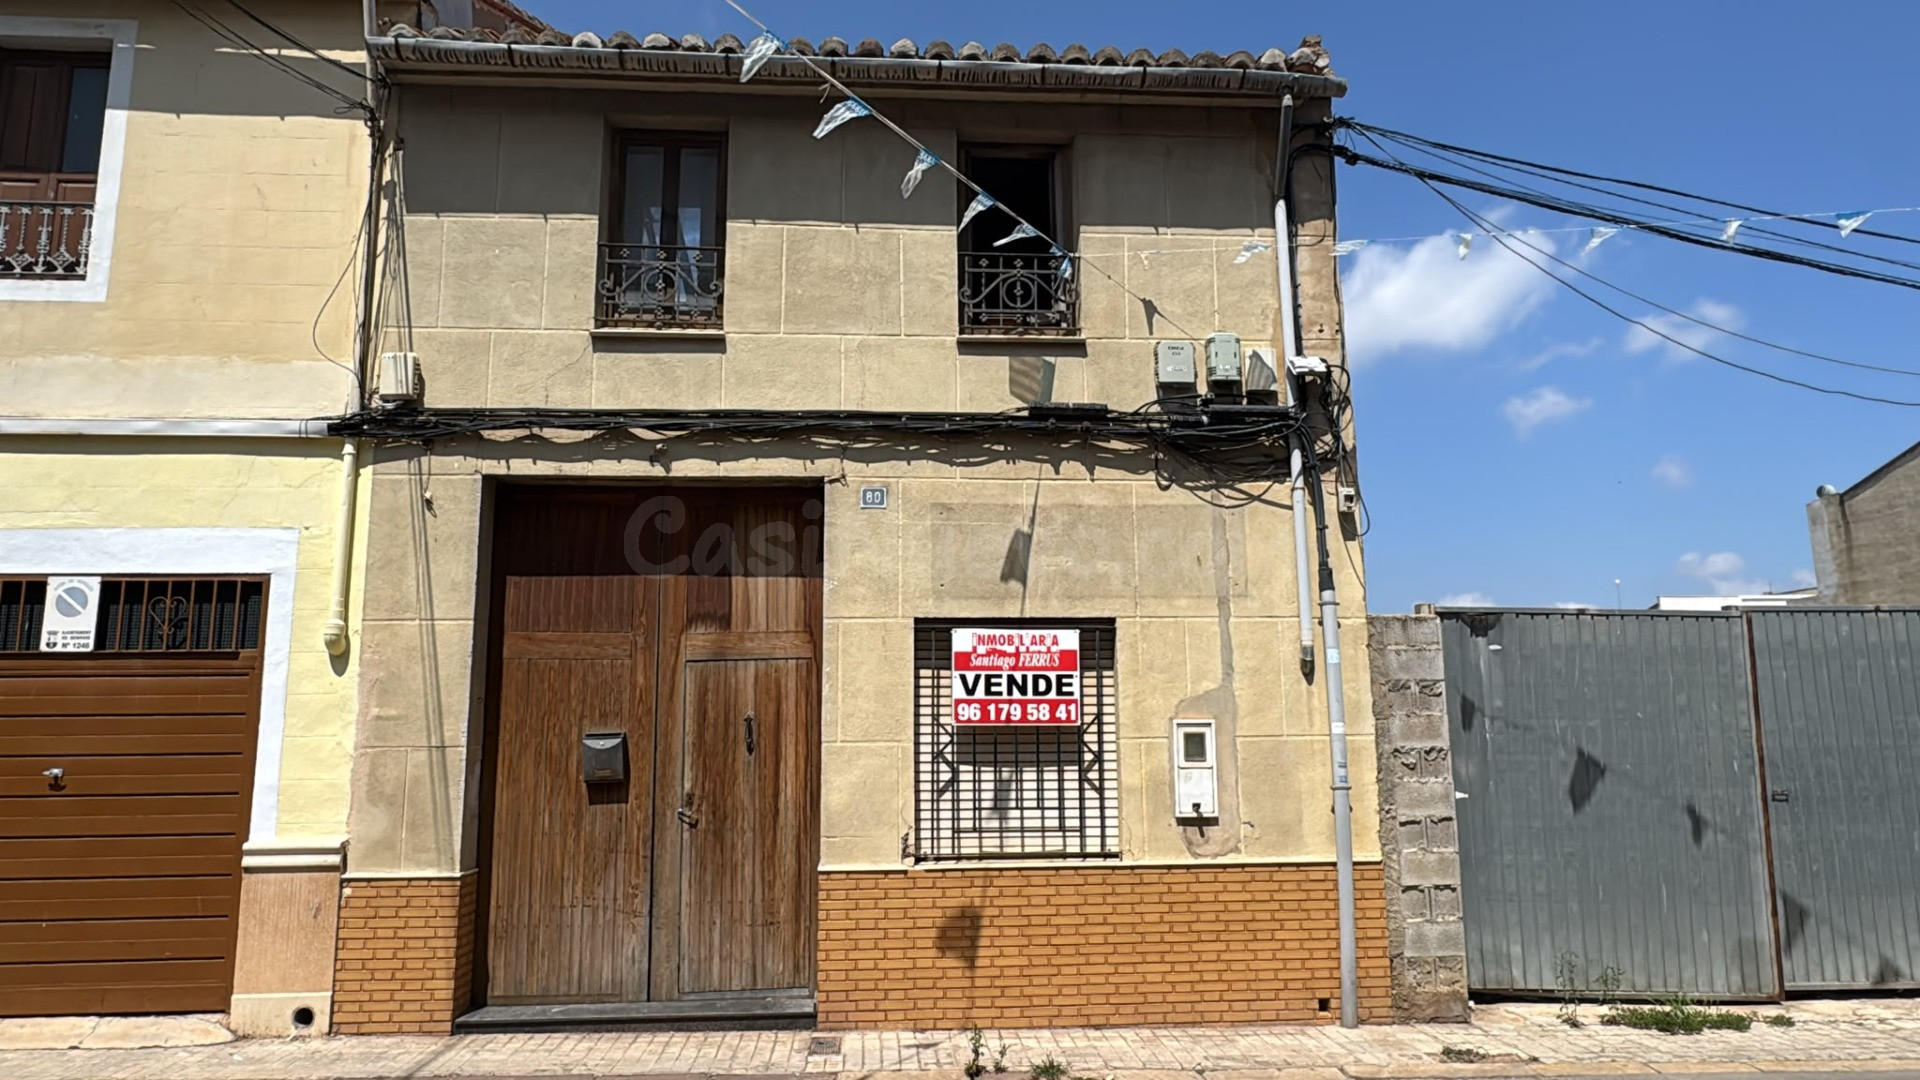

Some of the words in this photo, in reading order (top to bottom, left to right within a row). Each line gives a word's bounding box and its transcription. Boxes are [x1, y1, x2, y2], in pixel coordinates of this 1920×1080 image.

[866, 491, 881, 503] 80
[969, 653, 1016, 671] Santiago
[959, 673, 1075, 697] VENDE
[957, 703, 981, 721] 96
[987, 703, 1022, 721] 179
[1026, 703, 1051, 721] 58
[1055, 703, 1077, 721] 41
